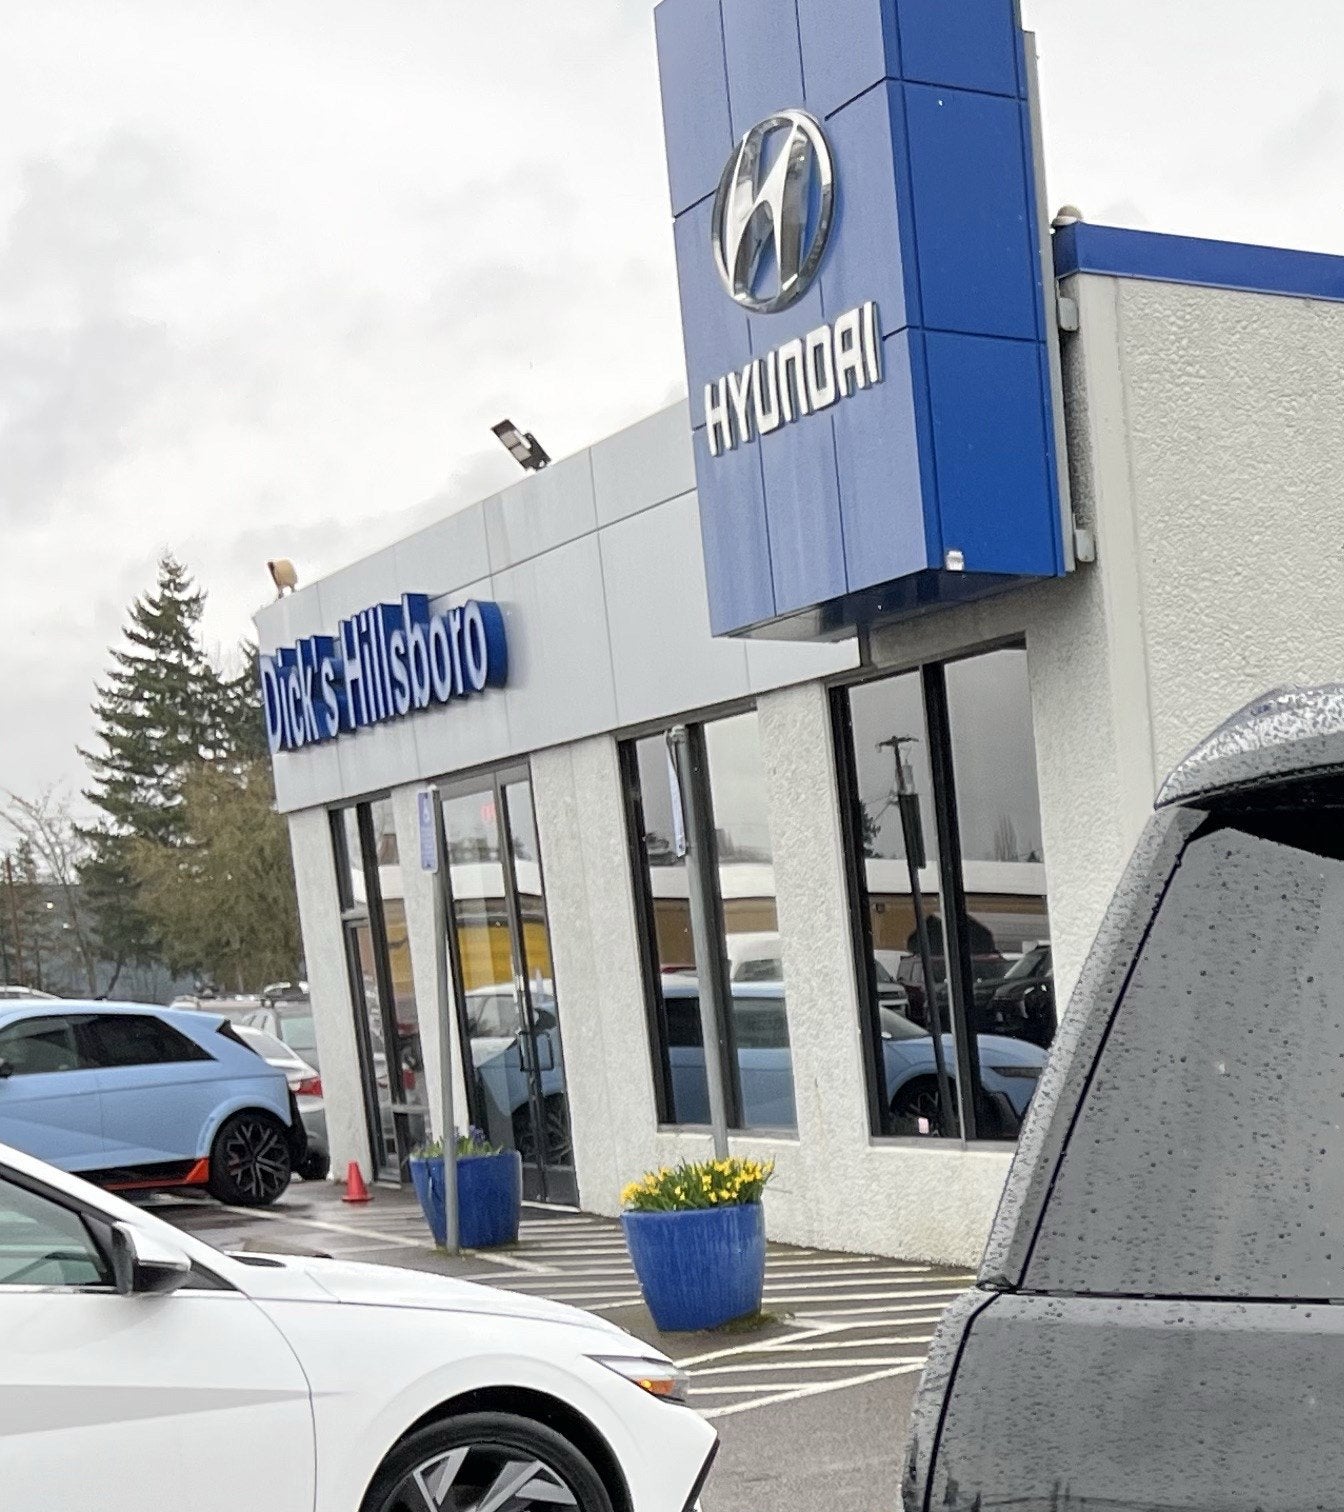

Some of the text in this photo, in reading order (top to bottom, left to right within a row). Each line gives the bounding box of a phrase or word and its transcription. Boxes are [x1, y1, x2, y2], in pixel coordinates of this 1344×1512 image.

[704, 301, 881, 457] HYUNDAI
[260, 593, 492, 752] Dick's Hillsboro
